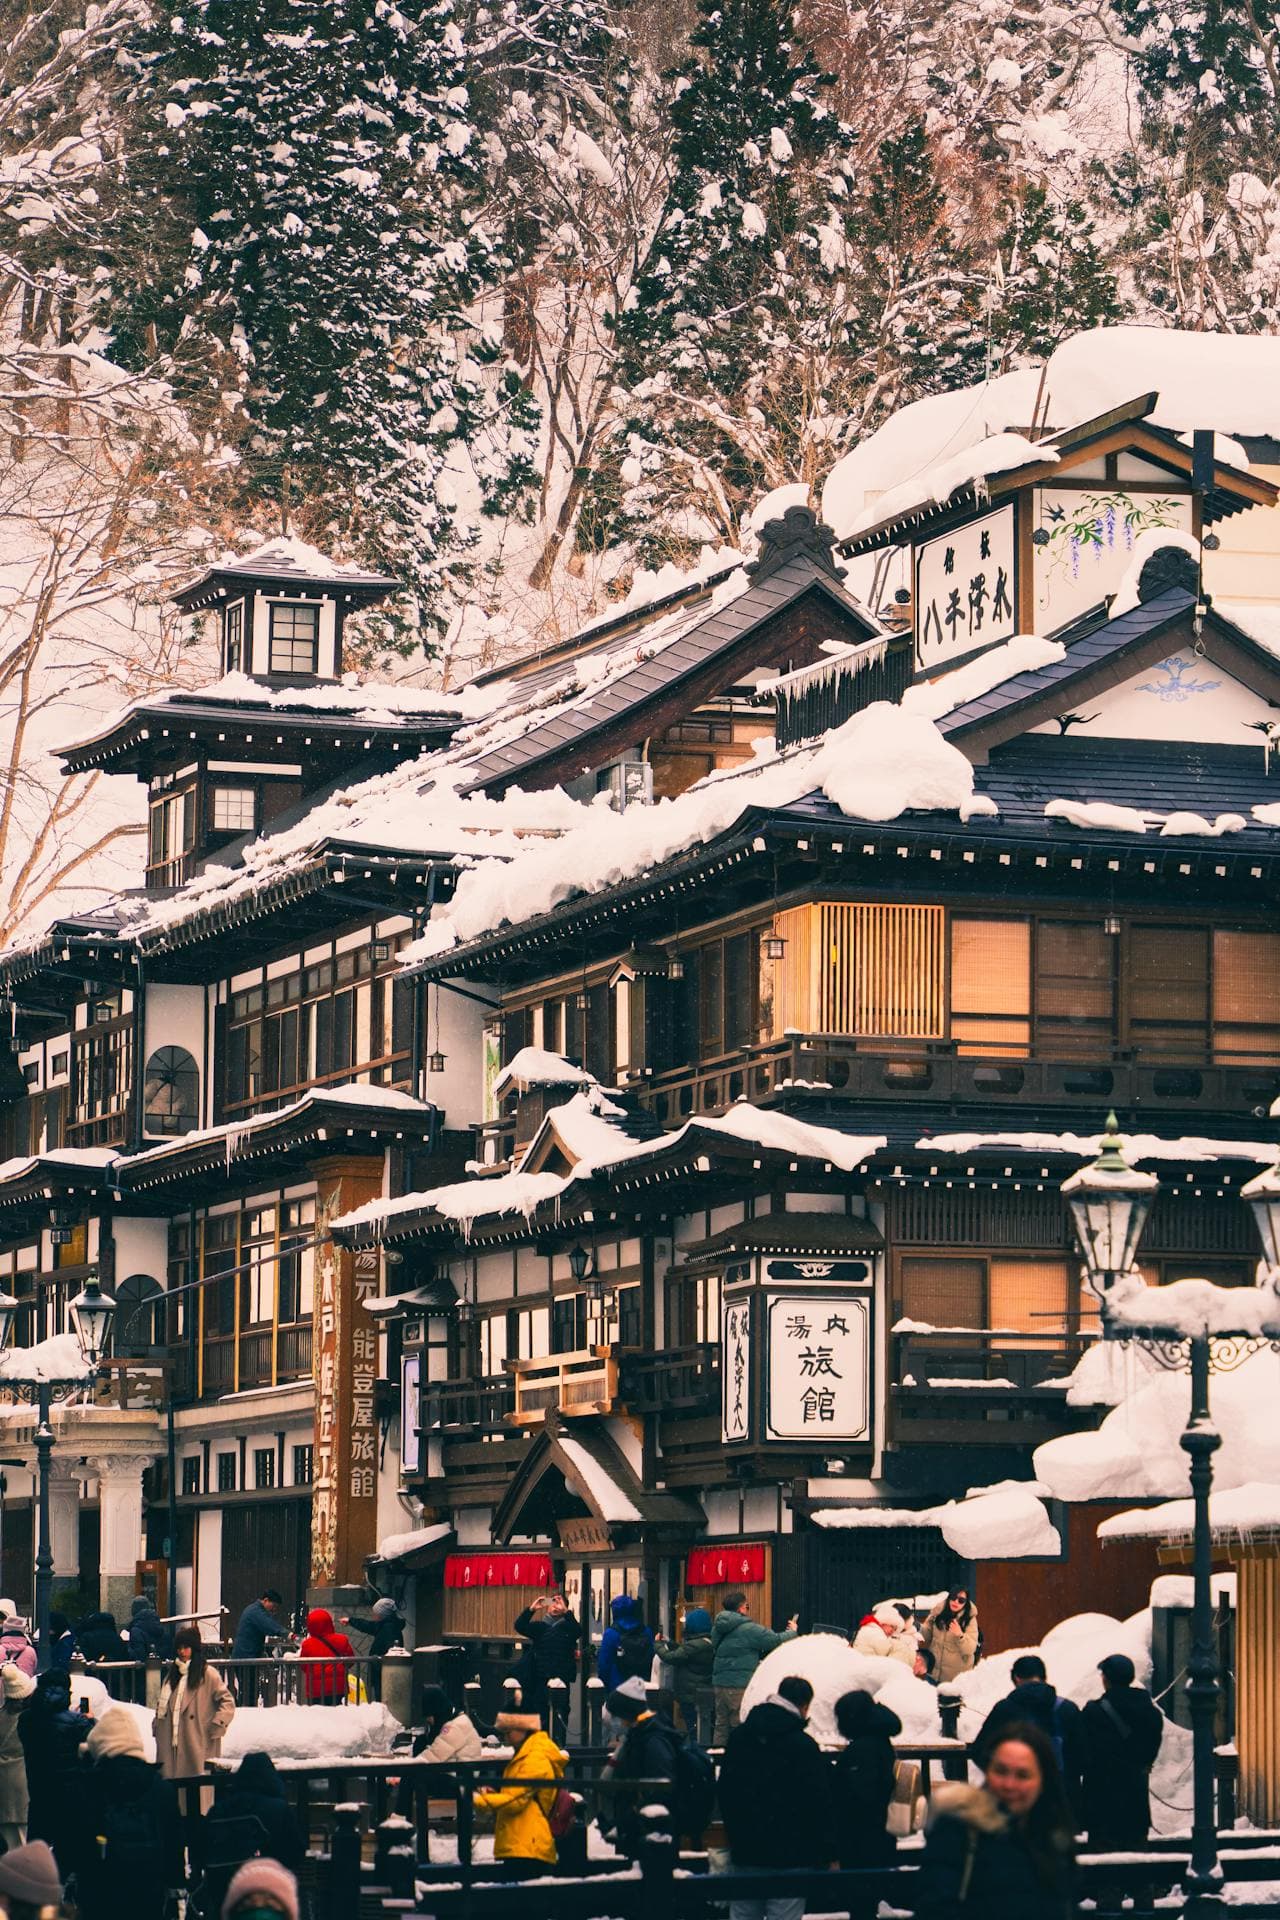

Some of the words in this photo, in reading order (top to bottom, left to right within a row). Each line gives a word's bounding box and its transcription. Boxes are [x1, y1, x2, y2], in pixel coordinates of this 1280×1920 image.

[350, 1327, 376, 1498] 能登屋旅館
[798, 1345, 843, 1423] 旅館
